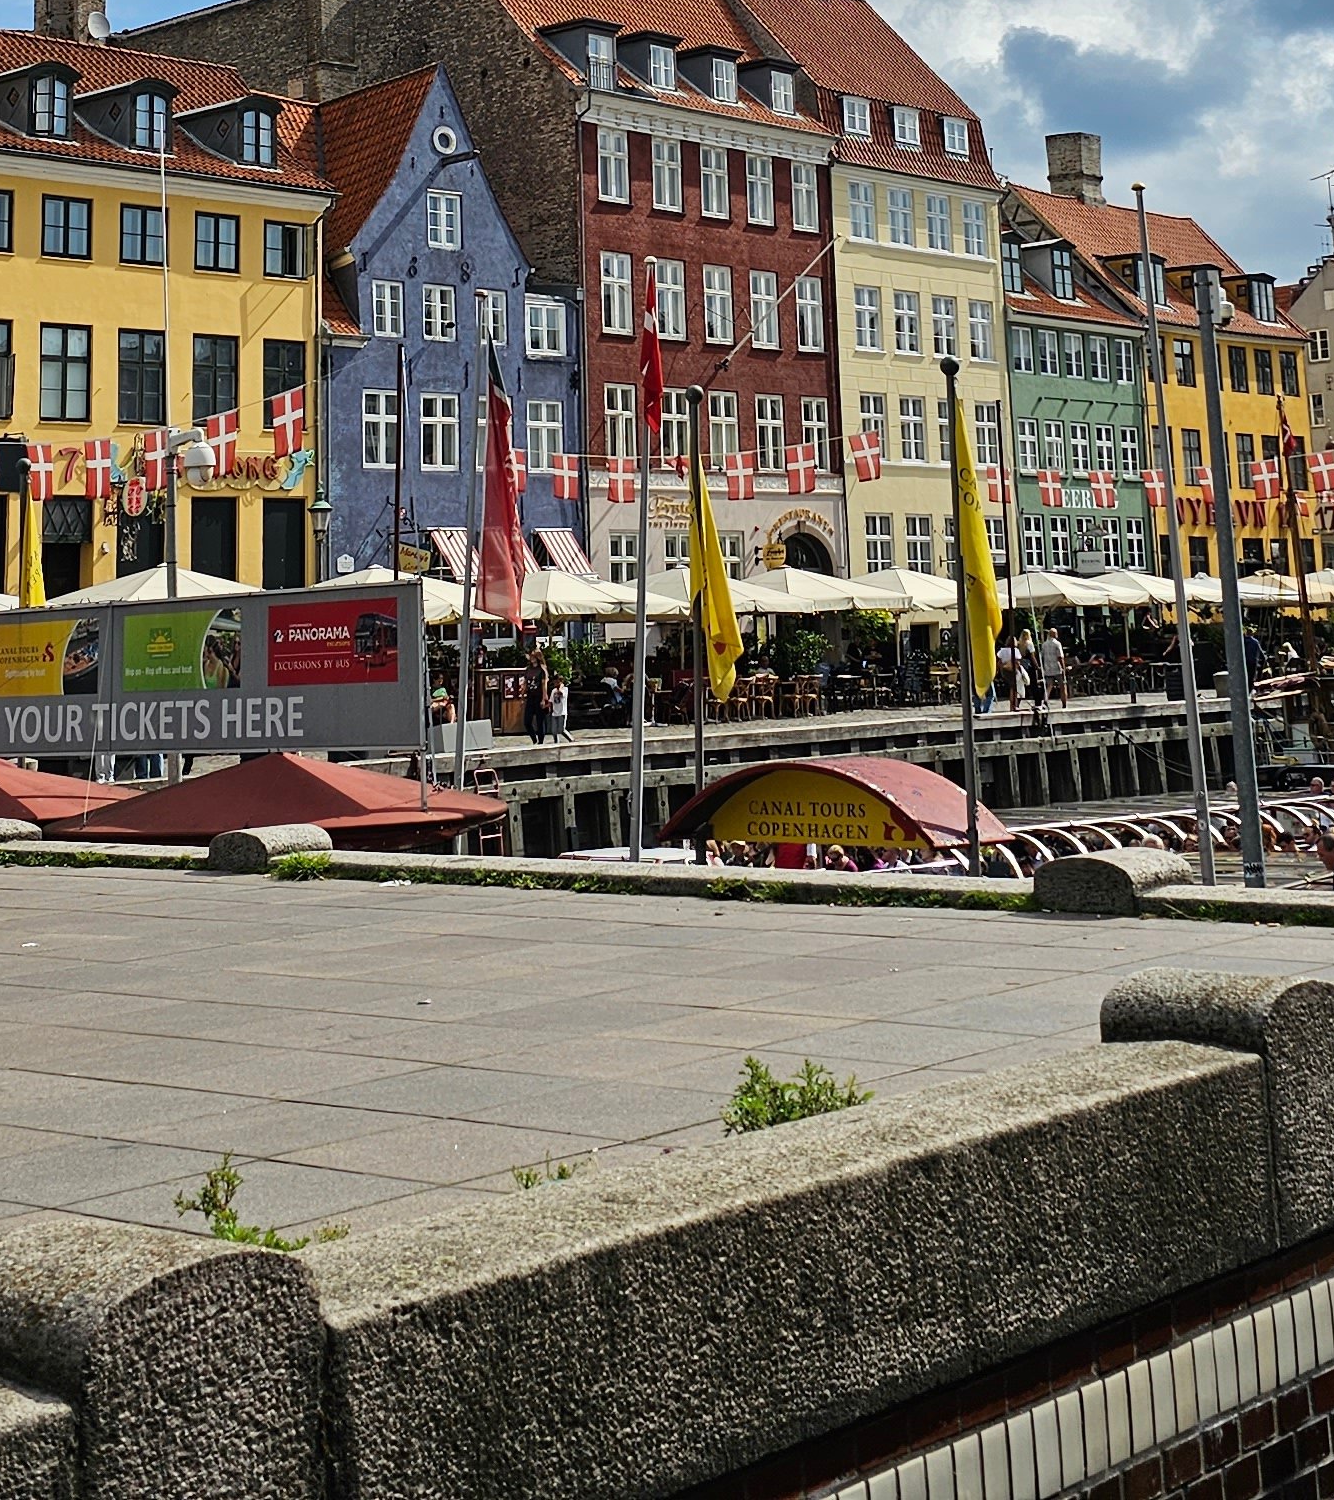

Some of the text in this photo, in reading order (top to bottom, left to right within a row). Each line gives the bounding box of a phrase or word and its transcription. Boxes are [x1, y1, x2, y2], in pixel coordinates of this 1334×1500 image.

[288, 626, 351, 642] PANORAMA
[274, 659, 350, 671] EXCURSIONS BY BUS
[4, 705, 83, 743] YOUR
[92, 700, 210, 741] TICKETS
[222, 696, 304, 739] HERE
[749, 800, 866, 818] CANAL TOURS
[747, 821, 869, 840] COPENHAGEN
